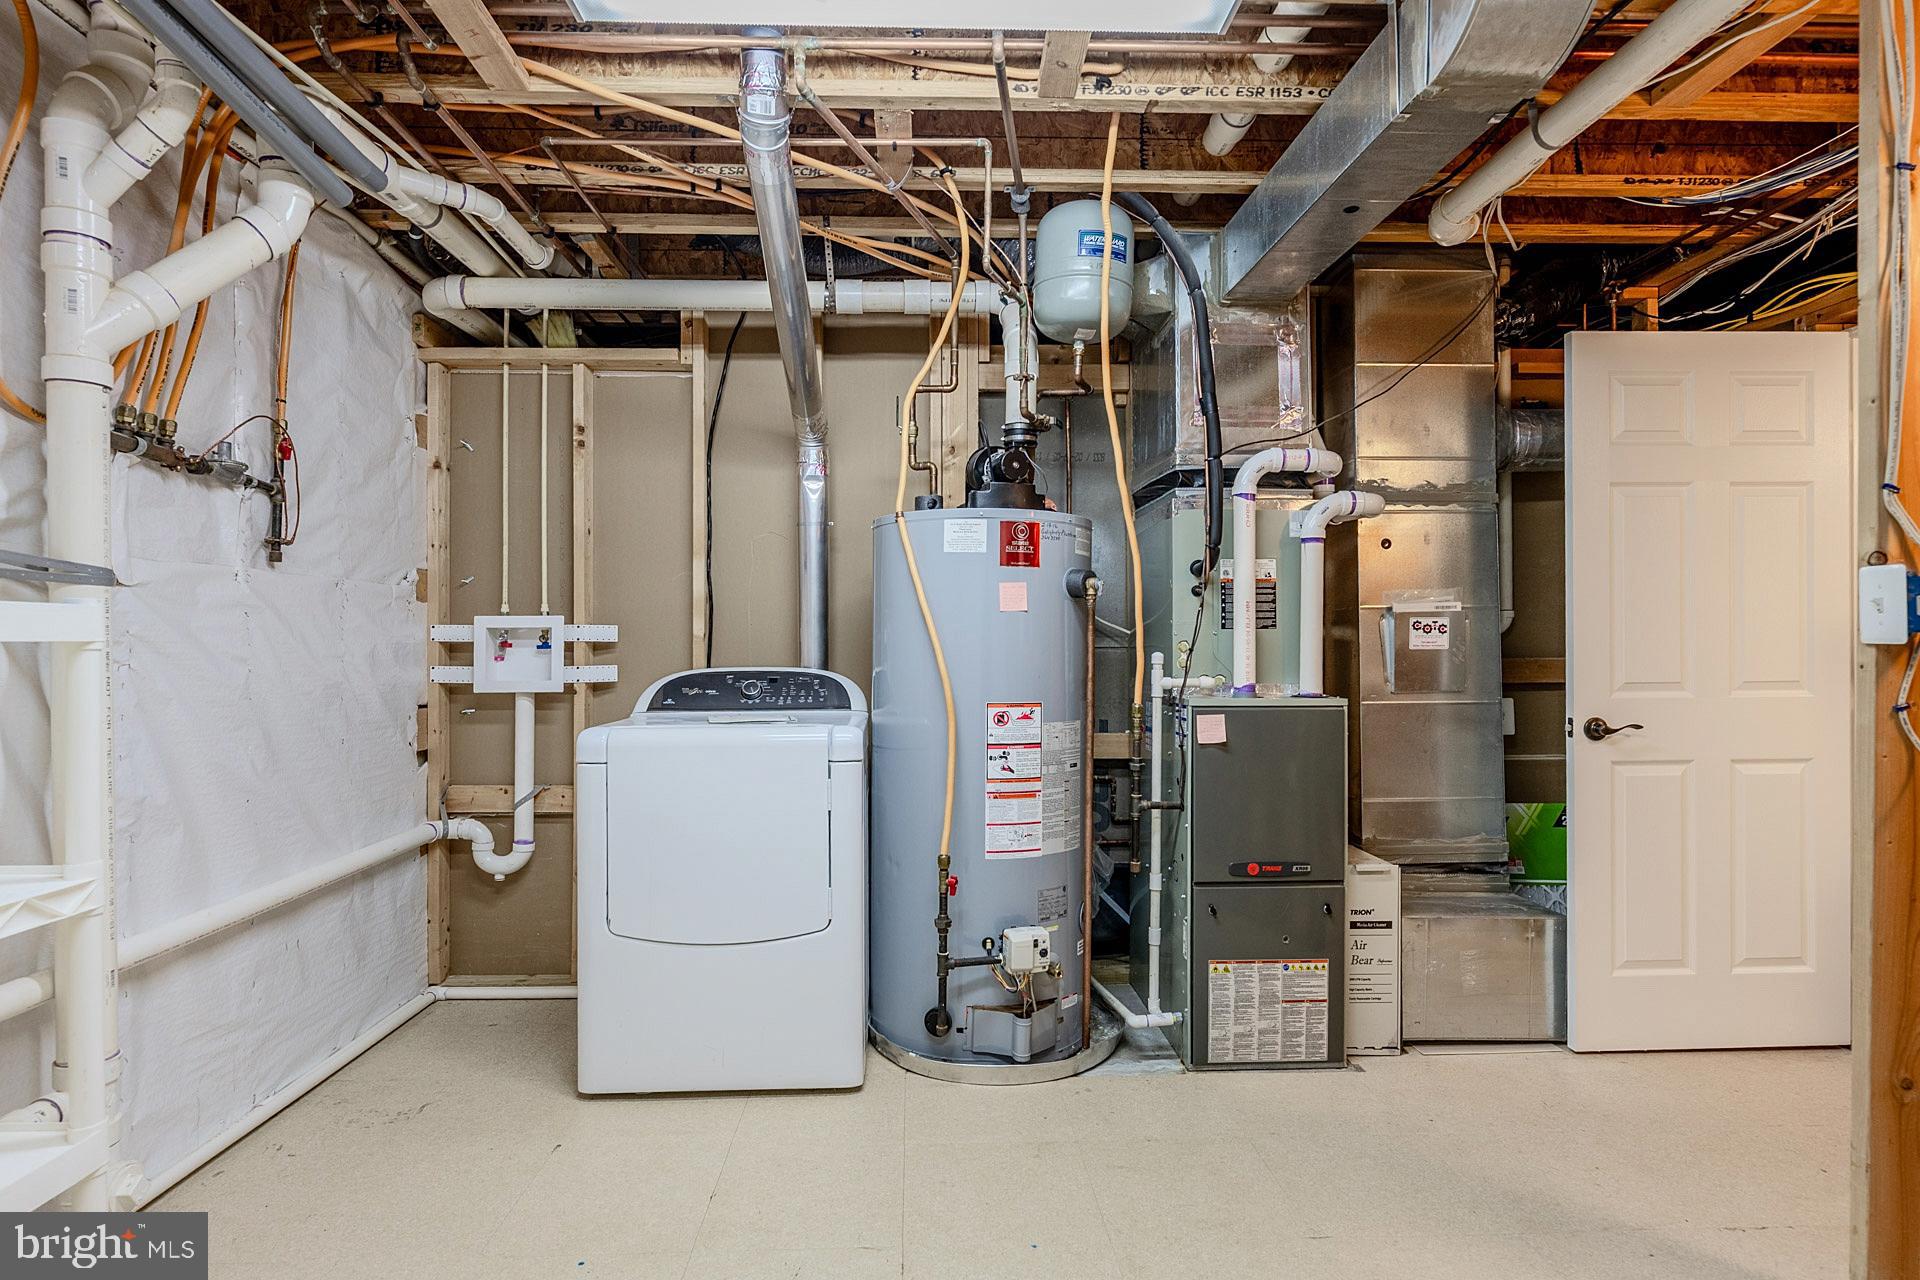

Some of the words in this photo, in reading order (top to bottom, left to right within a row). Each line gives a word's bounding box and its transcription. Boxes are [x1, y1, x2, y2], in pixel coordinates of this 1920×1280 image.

[1205, 86, 1229, 97] ICC
[1236, 86, 1265, 98] ESR
[1270, 87, 1302, 98] 1153
[720, 166, 746, 175] ESR
[1350, 939, 1368, 950] Air
[1351, 954, 1374, 966] Bear
